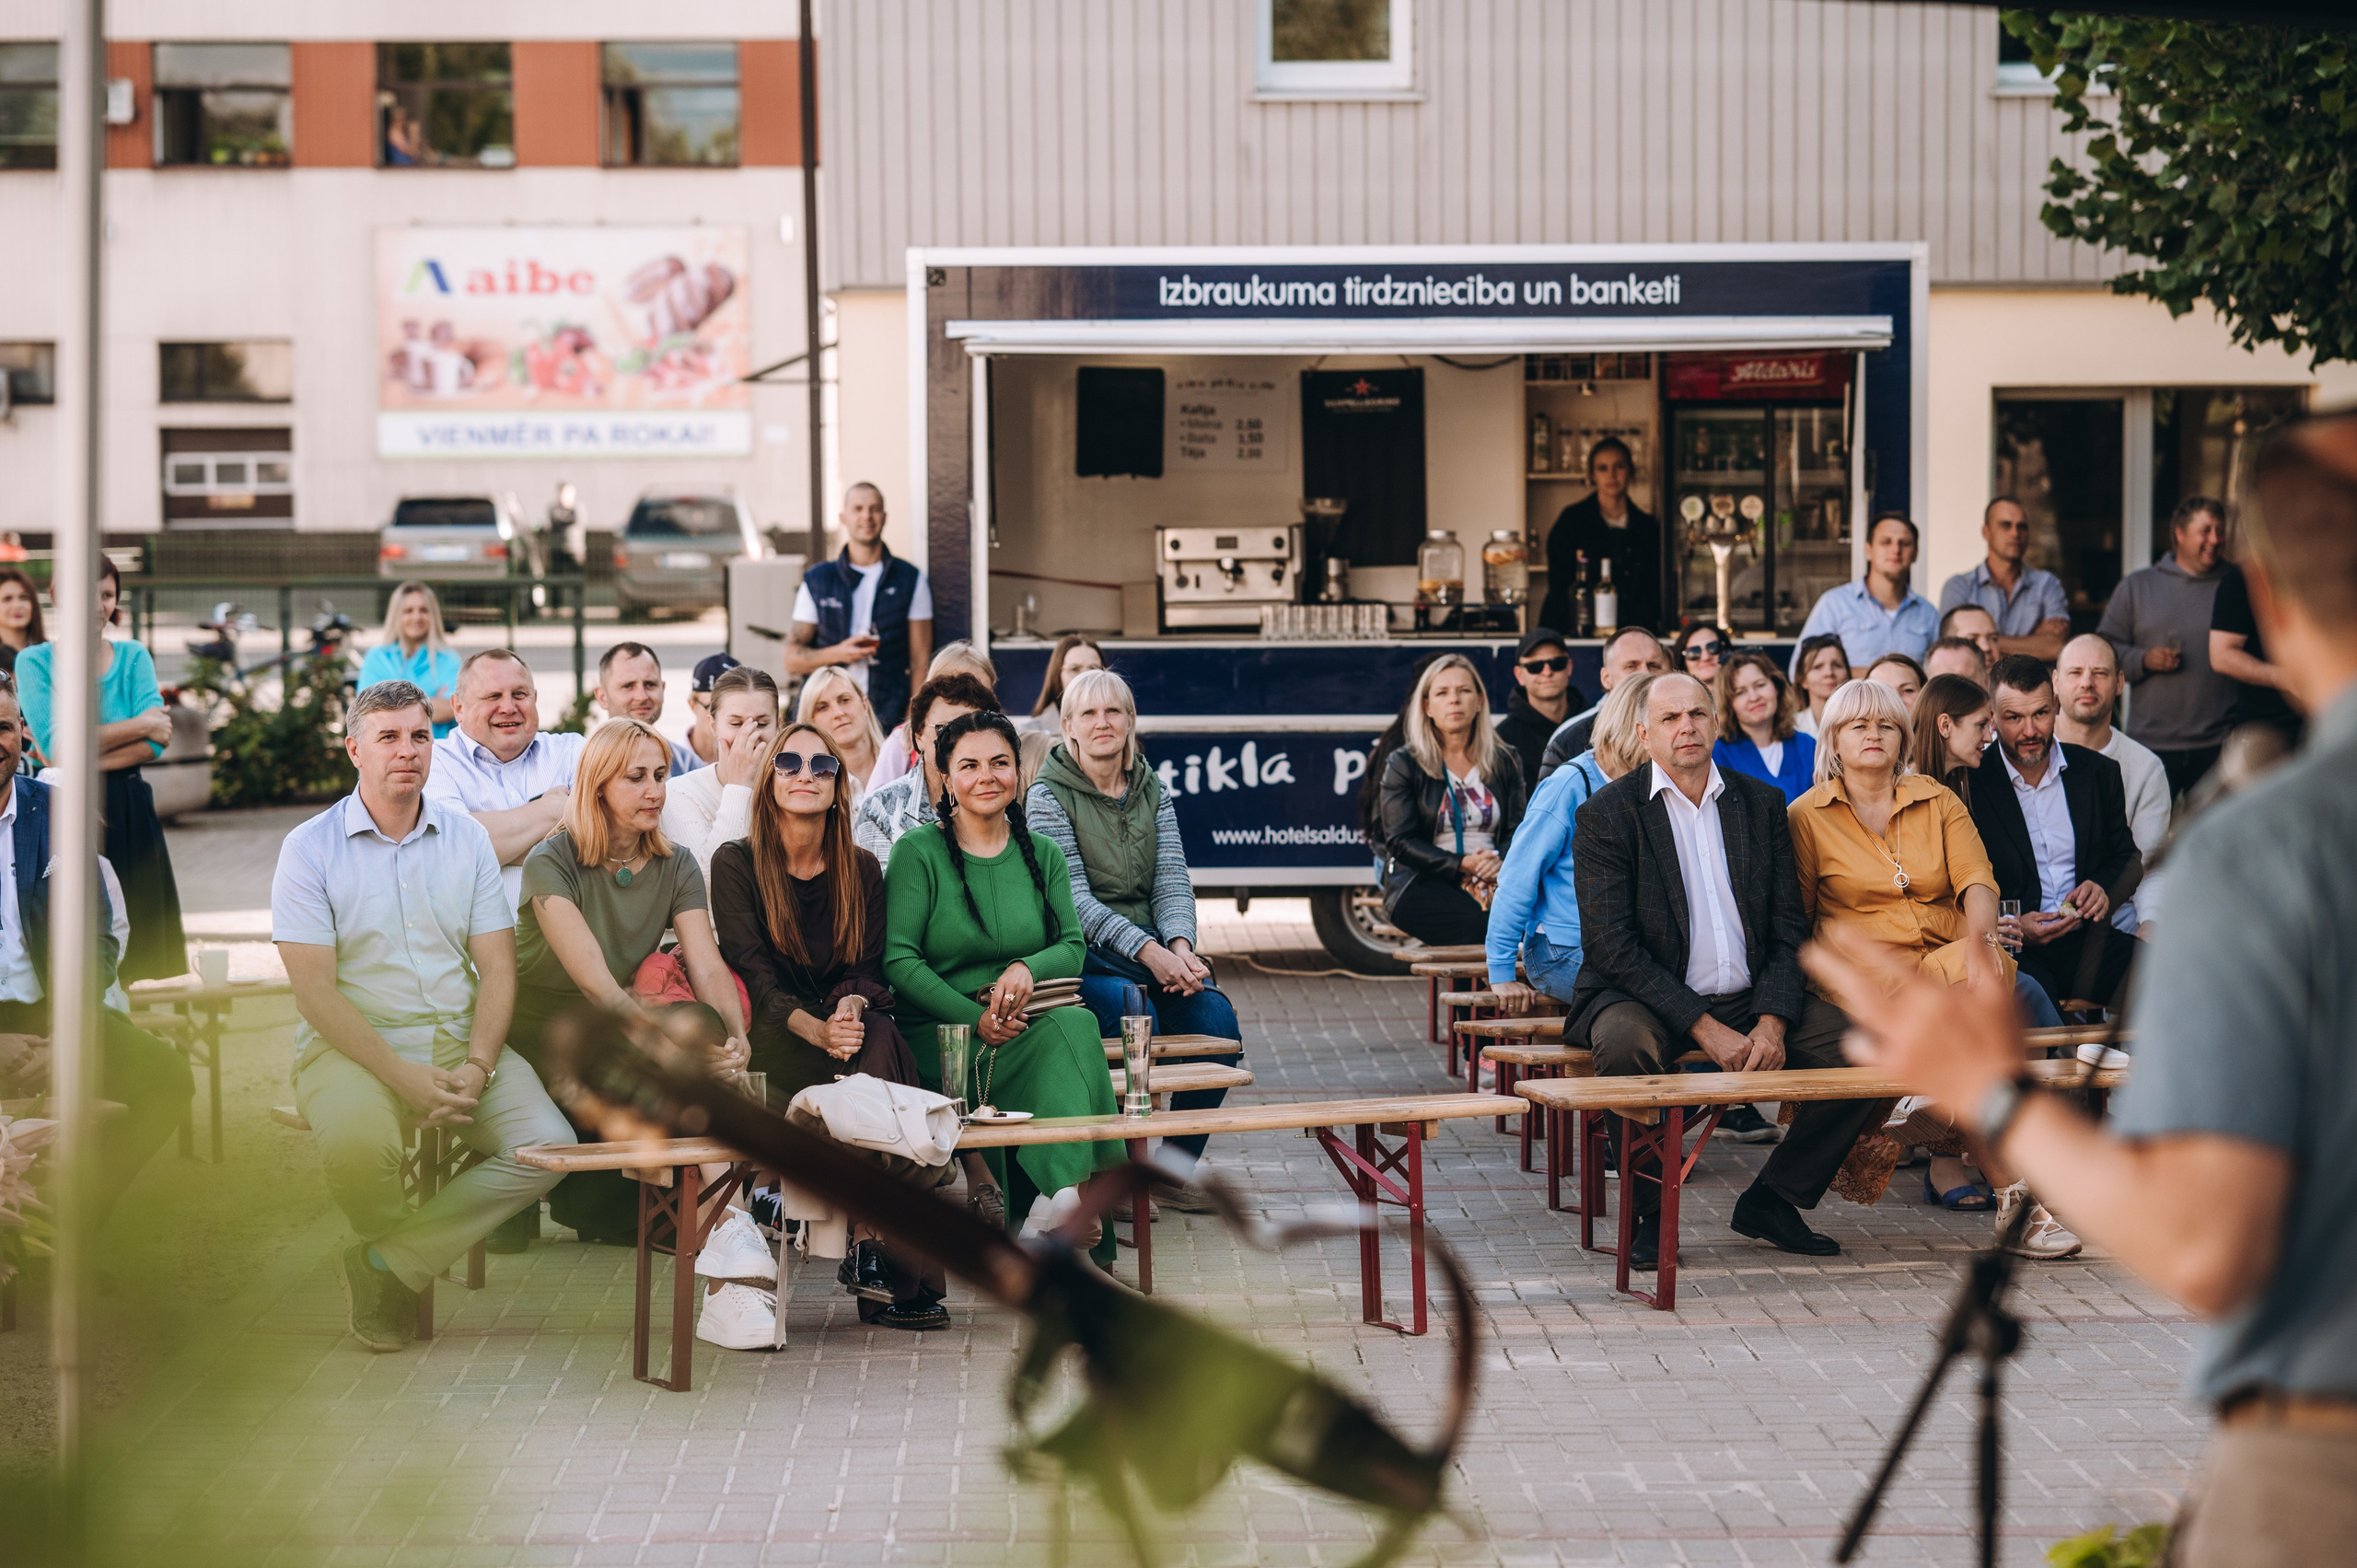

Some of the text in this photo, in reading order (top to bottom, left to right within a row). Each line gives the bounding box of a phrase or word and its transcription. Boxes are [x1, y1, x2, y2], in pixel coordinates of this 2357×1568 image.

[466, 259, 596, 296] aibe
[1159, 273, 1336, 307] Izbraukuma
[1523, 280, 1562, 306] un
[1570, 272, 1681, 305] banketi
[416, 419, 552, 447] VIENMĒR
[563, 422, 604, 447] PA
